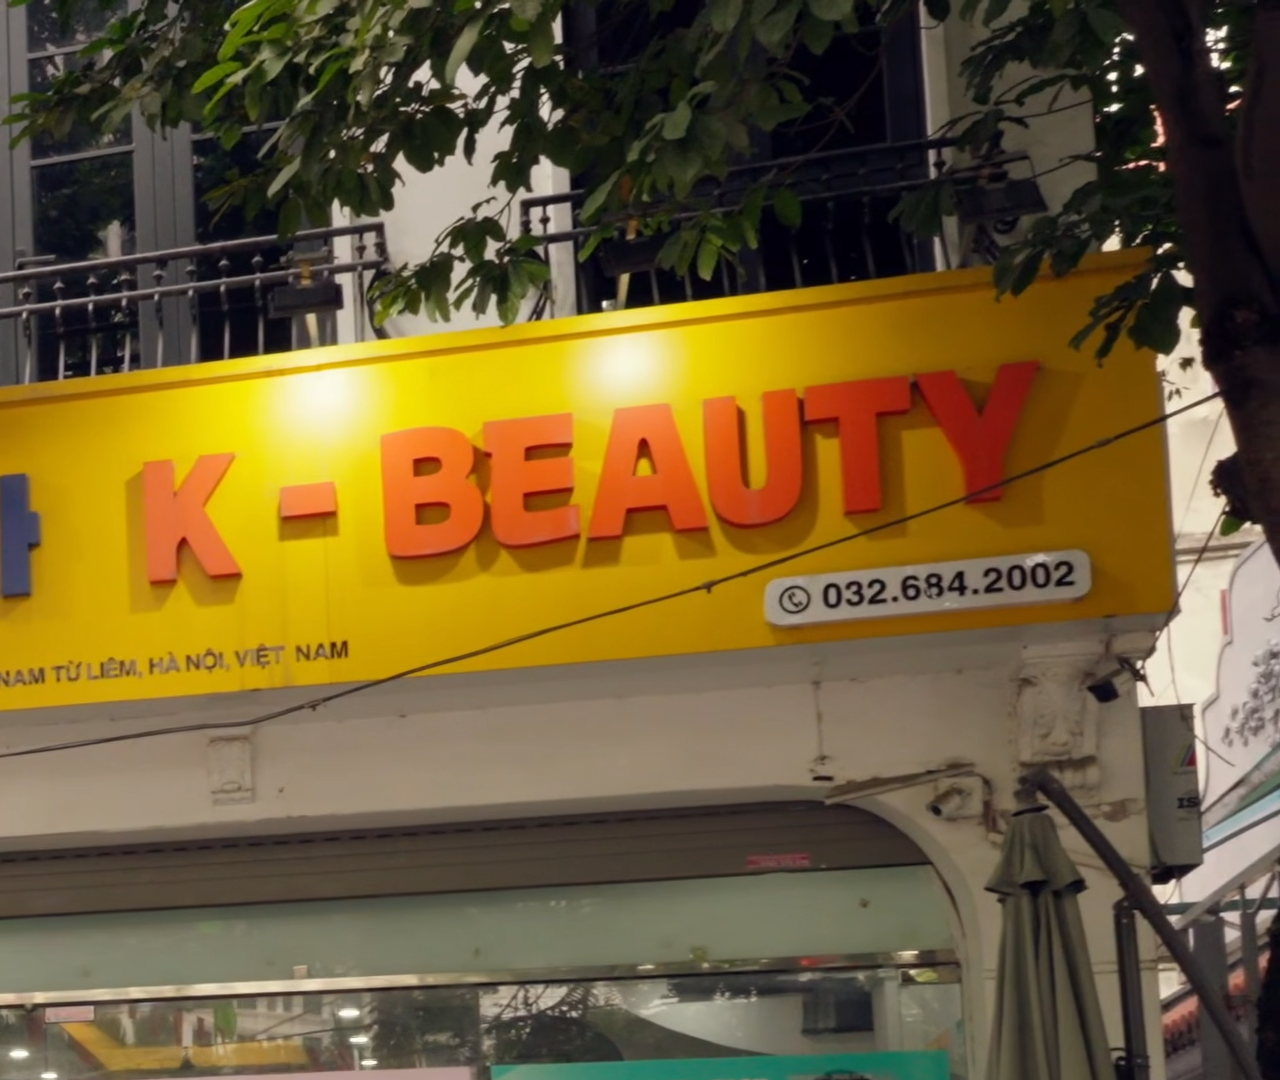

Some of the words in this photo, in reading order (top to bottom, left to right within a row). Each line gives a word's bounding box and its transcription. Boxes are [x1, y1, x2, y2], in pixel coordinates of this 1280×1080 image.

[142, 452, 242, 585] K
[380, 361, 1038, 558] BEAUTY
[822, 560, 1075, 608] 032.684.2002
[51, 660, 82, 683] TỪ
[86, 657, 142, 681] LIÊM,
[149, 651, 181, 676] HÀ
[186, 647, 230, 674] NỘI,
[234, 643, 285, 668] VIỆT
[296, 640, 349, 662] NAM
